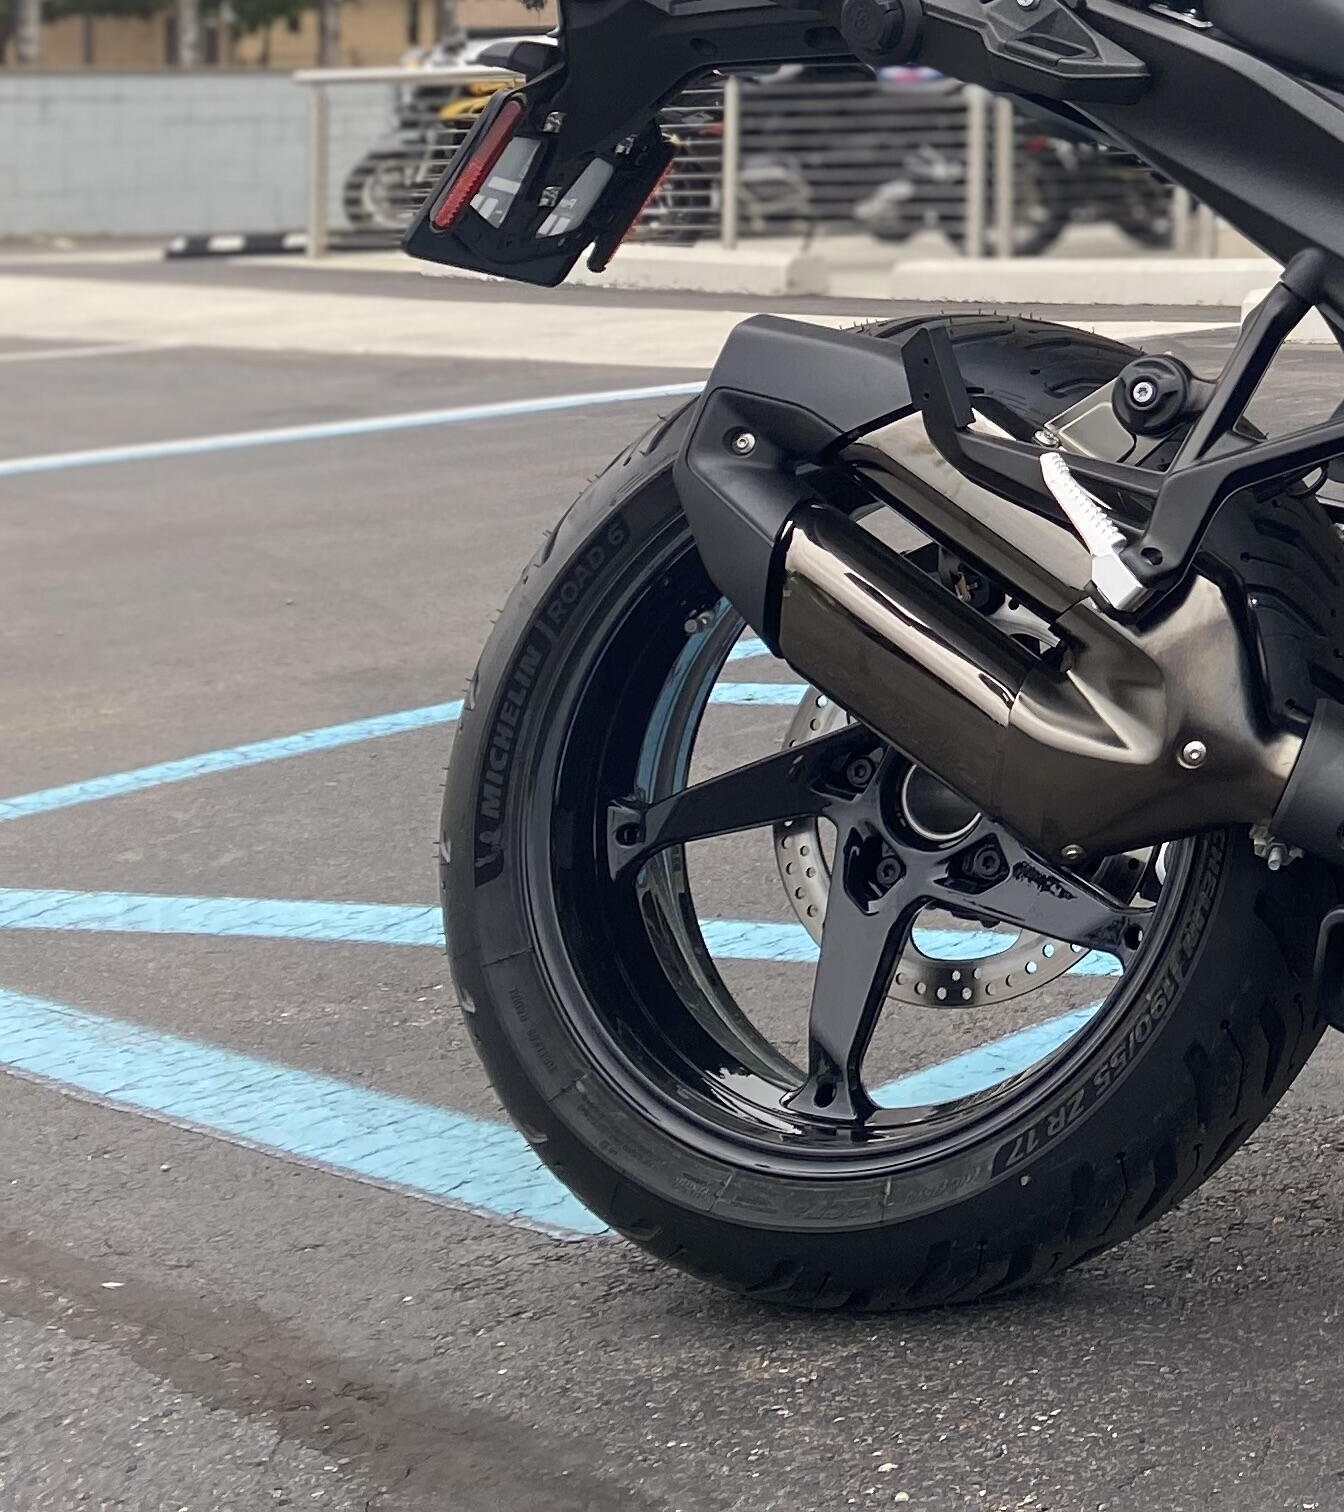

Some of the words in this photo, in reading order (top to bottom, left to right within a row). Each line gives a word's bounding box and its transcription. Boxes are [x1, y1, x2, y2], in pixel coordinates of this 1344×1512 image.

[481, 642, 544, 821] MICHELIN
[548, 545, 608, 627] ROAD
[608, 525, 625, 548] 6
[1090, 973, 1179, 1097] 190/55
[1003, 1121, 1041, 1167] 17
[1043, 1089, 1086, 1136] ZR
